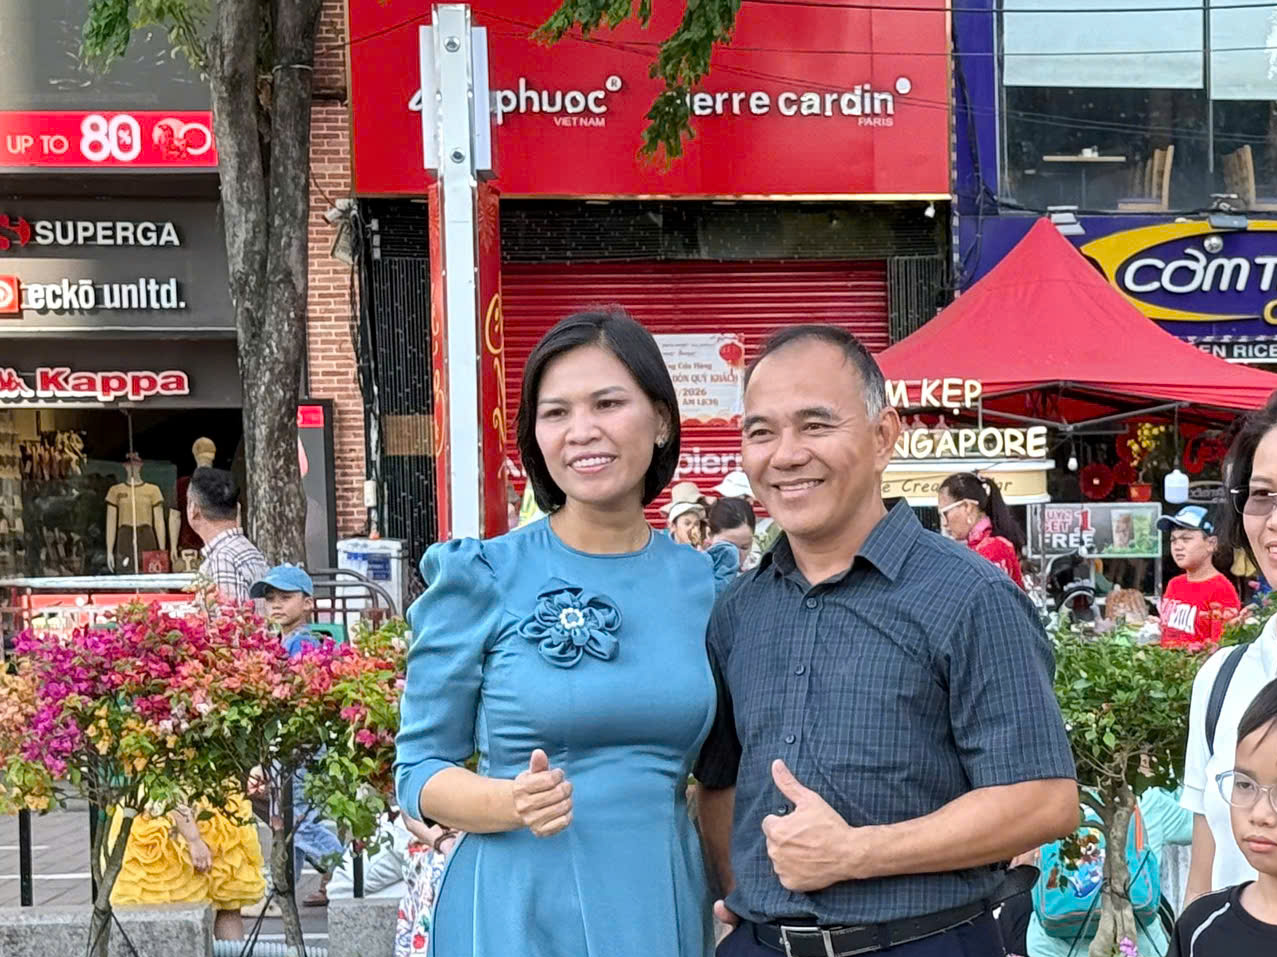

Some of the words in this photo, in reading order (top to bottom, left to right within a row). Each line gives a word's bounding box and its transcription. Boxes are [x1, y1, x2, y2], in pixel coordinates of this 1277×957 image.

[685, 90, 771, 116] erre
[777, 83, 895, 117] cardin
[857, 116, 894, 128] PARIS
[6, 135, 34, 155] UP
[40, 135, 70, 155] TO
[34, 220, 181, 247] SUPERGA
[103, 278, 187, 310] unltd.
[37, 367, 190, 401] Kappa
[920, 378, 982, 415] KẸP
[894, 425, 1048, 459] NGAPORE
[901, 478, 940, 493] Crea
